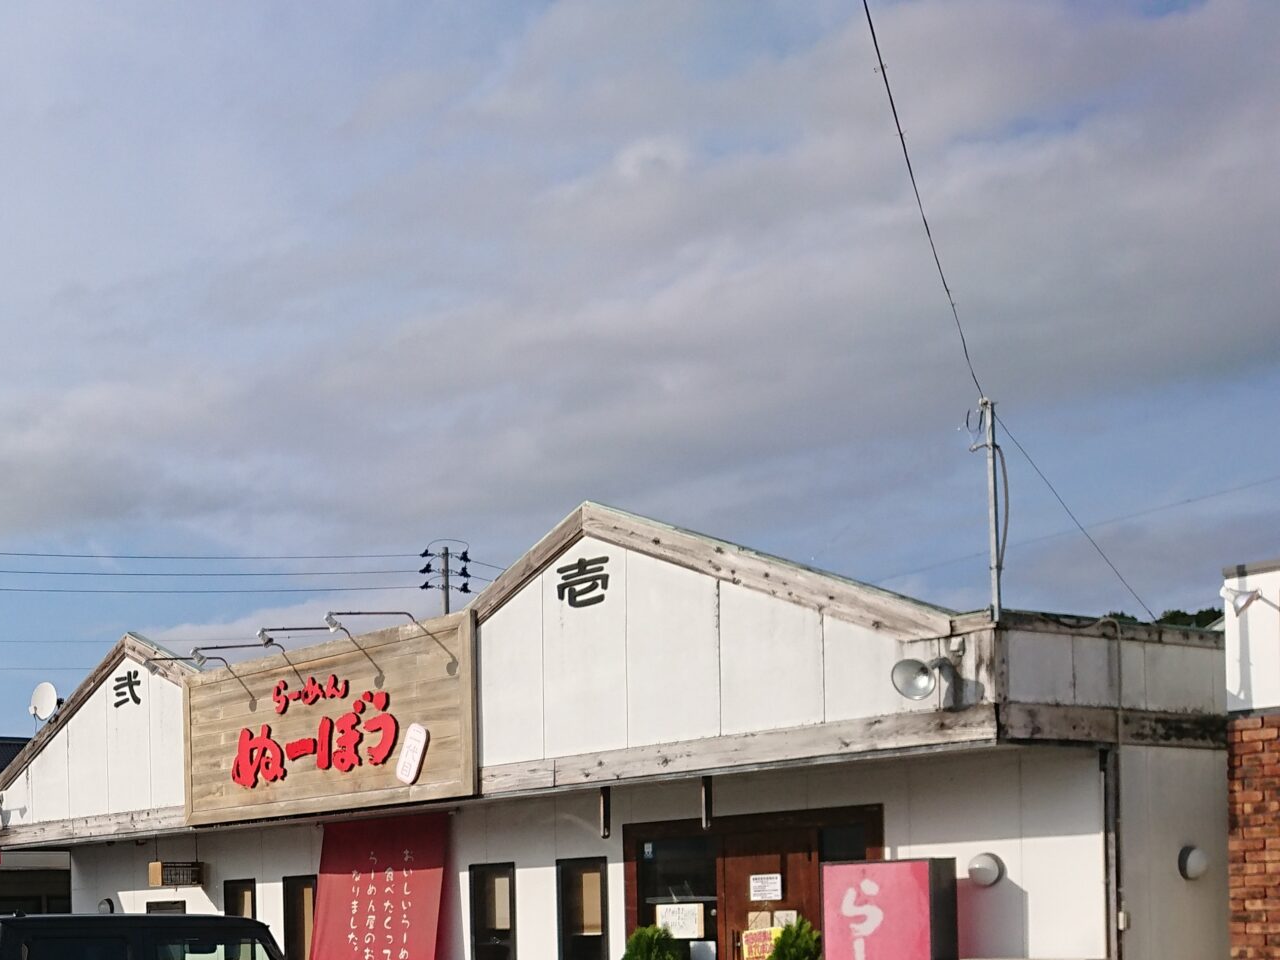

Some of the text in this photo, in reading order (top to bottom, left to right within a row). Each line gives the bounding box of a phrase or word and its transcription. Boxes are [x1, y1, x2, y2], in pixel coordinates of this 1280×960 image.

[556, 555, 609, 608] 壱
[113, 669, 141, 708] 弐
[272, 674, 350, 714] らーめん
[231, 691, 400, 789] ぬーぼう
[400, 728, 422, 778] 二代目
